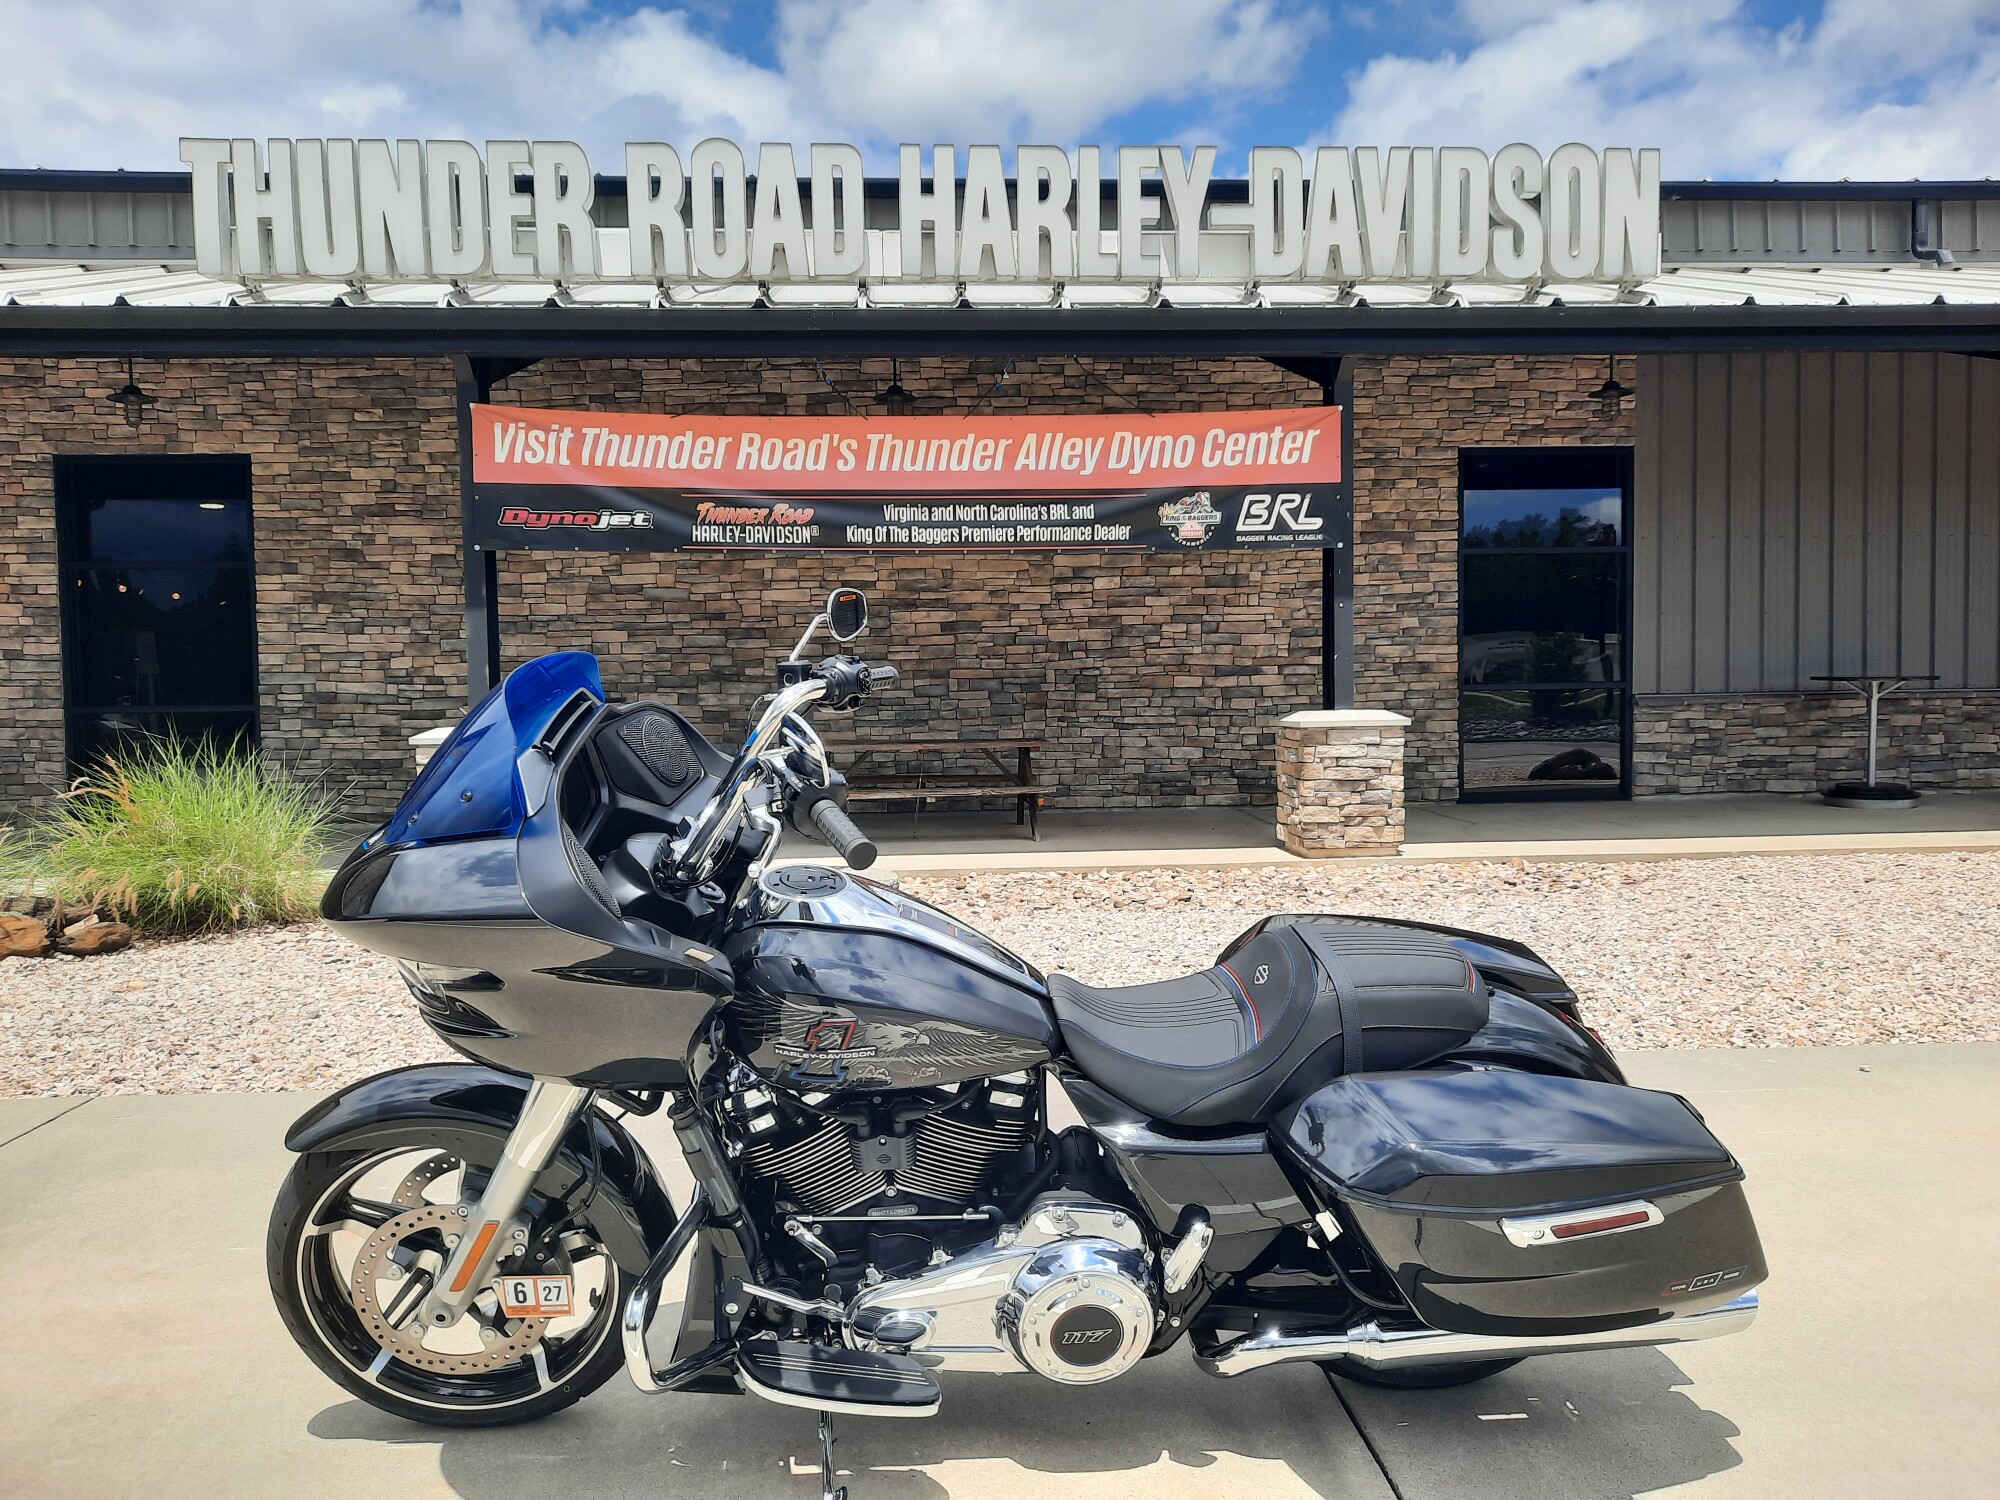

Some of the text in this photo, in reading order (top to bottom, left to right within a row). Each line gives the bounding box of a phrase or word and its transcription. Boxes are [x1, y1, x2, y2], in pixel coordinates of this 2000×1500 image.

[179, 137, 1661, 279] THUNDER ROAD HARLEY-DAVIDSON
[493, 421, 1321, 475] Visit Thunder Road's Thunder Alley Dyno Center
[499, 508, 653, 530] Dynojet
[883, 503, 1095, 523] Virginia and North Carolina's BRL and
[1236, 493, 1324, 531] BRL
[846, 523, 1132, 545] King Of The Baggers Premiere Performance Dealer
[1236, 533, 1324, 542] BAGGER RACING LEAGUE
[774, 1048, 876, 1060] HARLEY-DAVIDSON
[513, 1281, 527, 1304] 6
[542, 1285, 562, 1302] 27
[1062, 1329, 1114, 1345] 117
